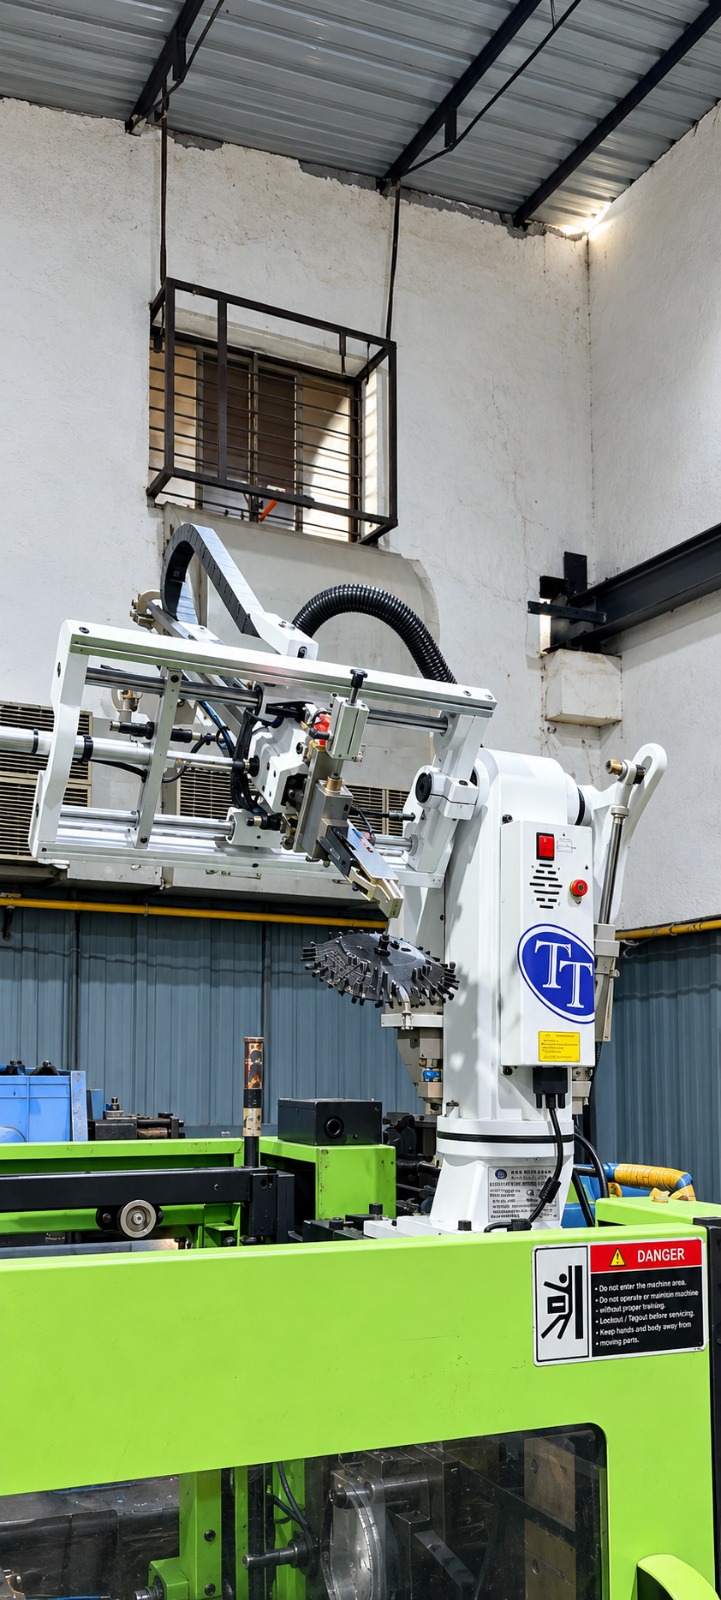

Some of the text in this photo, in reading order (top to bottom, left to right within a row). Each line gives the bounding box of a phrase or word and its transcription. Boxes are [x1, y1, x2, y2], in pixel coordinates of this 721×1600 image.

[534, 939, 593, 1008] TT
[637, 1248, 685, 1263] DANGER
[599, 1284, 608, 1292] Do
[646, 1280, 671, 1288] machine
[599, 1296, 608, 1304] Do
[620, 1294, 642, 1303] operate
[674, 1290, 699, 1298] machine
[600, 1305, 622, 1313] without
[622, 1304, 642, 1313] proper
[628, 1313, 648, 1323] Tagout
[648, 1312, 668, 1320] before
[599, 1321, 692, 1336] Keep hands and body away from
[599, 1337, 640, 1347] moving parts.
